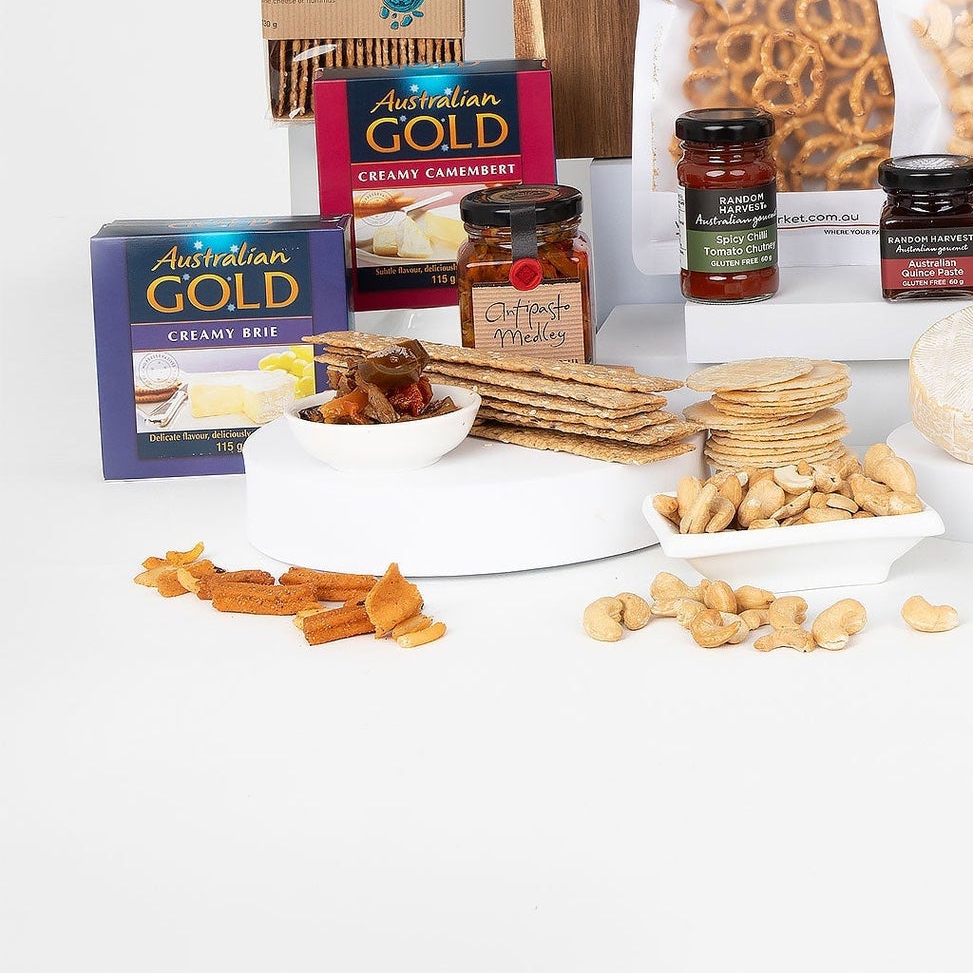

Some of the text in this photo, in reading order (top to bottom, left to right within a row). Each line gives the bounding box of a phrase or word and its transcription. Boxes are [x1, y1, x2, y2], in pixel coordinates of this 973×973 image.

[369, 84, 502, 114] Australian
[365, 112, 509, 154] GOLD
[357, 163, 516, 183] CREAMY CAMEMBERT
[719, 192, 764, 205] RANDOM
[694, 213, 753, 227] Australian
[777, 213, 859, 224] rket.com.au
[716, 229, 768, 246] Spicy Chilli
[887, 235, 929, 245] RANDOM
[703, 241, 776, 257] Tomato Chutney
[895, 244, 938, 254] Australian
[150, 241, 291, 272] Australian
[710, 259, 741, 267] GLUTEN
[741, 257, 759, 266] FREE
[375, 264, 458, 276] Subtle flavour, deliciousl
[908, 258, 957, 269] Australian
[431, 274, 456, 285] 115 g
[901, 268, 964, 278] Quince Paste
[902, 279, 929, 287] GLUTEN
[146, 271, 299, 314] GOLD
[167, 326, 278, 342] CREAMY BRIE
[149, 430, 181, 443] Delicate
[182, 430, 211, 443] flavour,
[216, 441, 243, 453] 115 g
